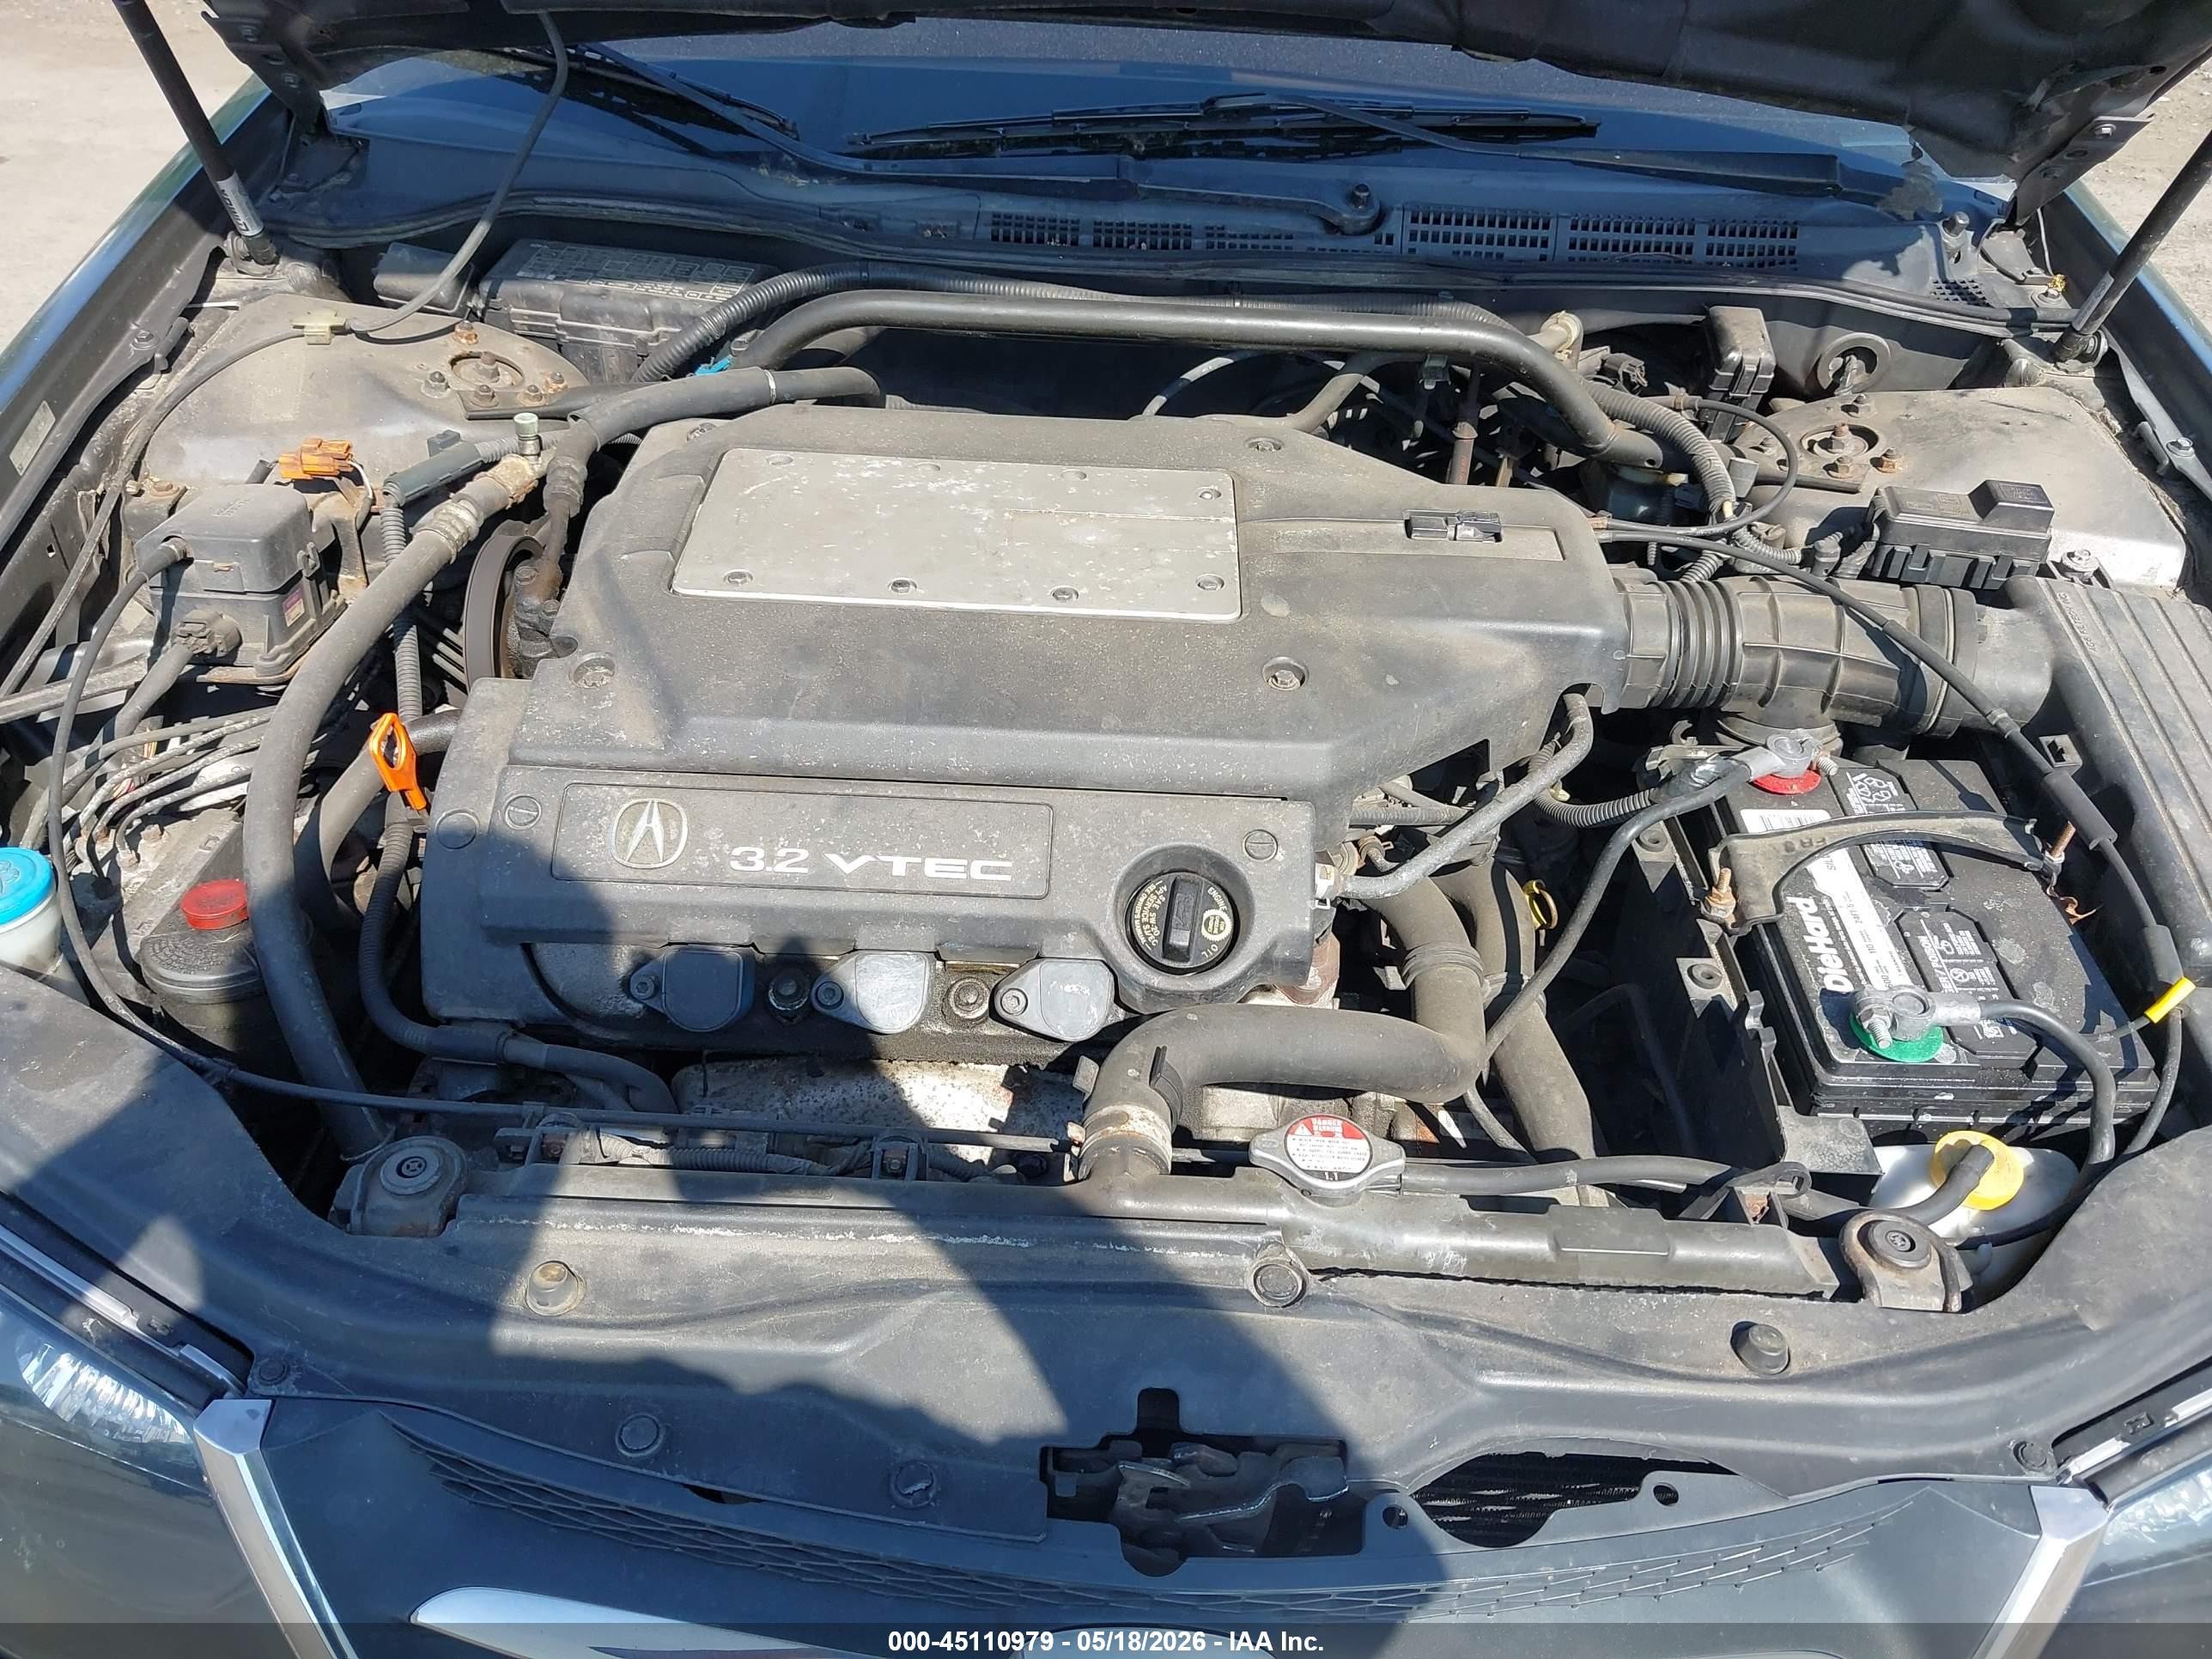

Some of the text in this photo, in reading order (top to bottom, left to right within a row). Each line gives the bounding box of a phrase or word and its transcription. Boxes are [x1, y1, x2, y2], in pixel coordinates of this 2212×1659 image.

[730, 847, 1012, 881] 3.2 VTEC
[1141, 894, 1158, 923] SERVICE
[1201, 886, 1228, 958] ENGINE OIL
[1786, 896, 1855, 993] DieHard
[1917, 935, 1943, 969] POISON
[1324, 1171, 1340, 1181] 1.1
